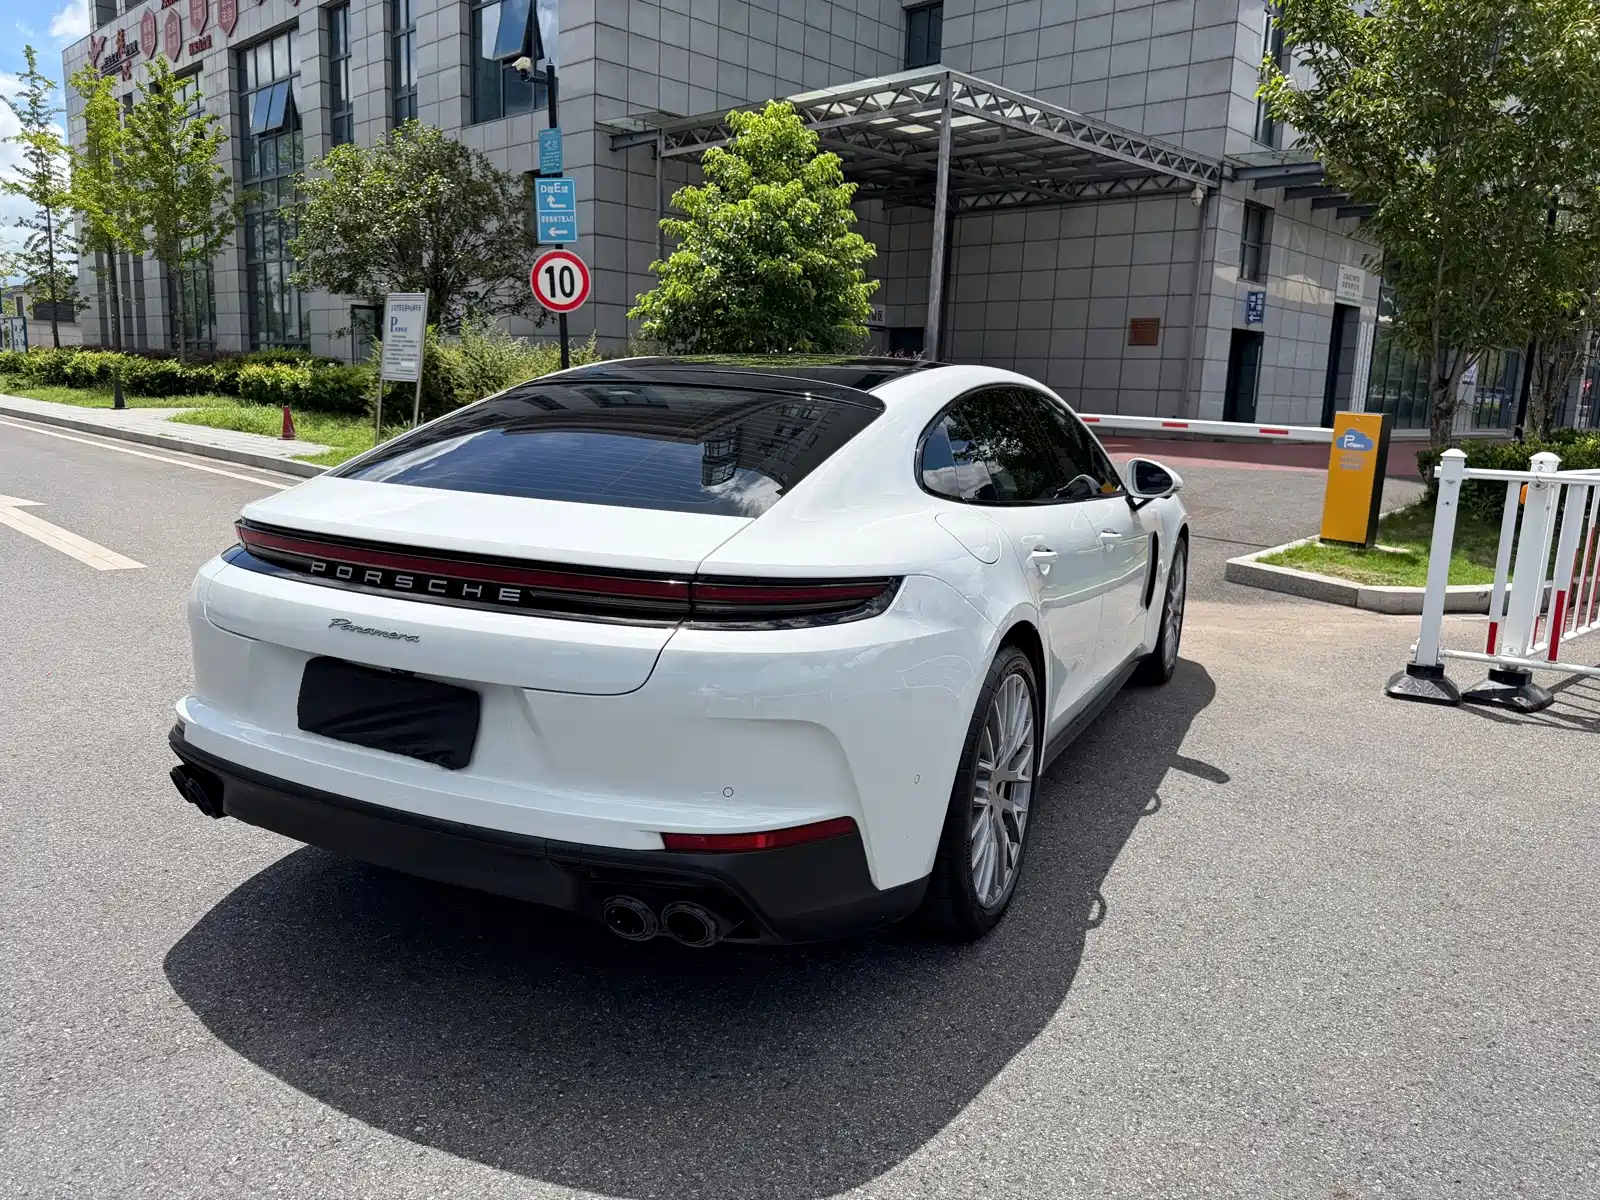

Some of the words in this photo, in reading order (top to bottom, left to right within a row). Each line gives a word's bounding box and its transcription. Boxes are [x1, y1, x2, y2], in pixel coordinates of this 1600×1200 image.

[544, 265, 575, 298] 10
[310, 561, 521, 602] PORSCHE
[328, 617, 420, 643] Panamera
